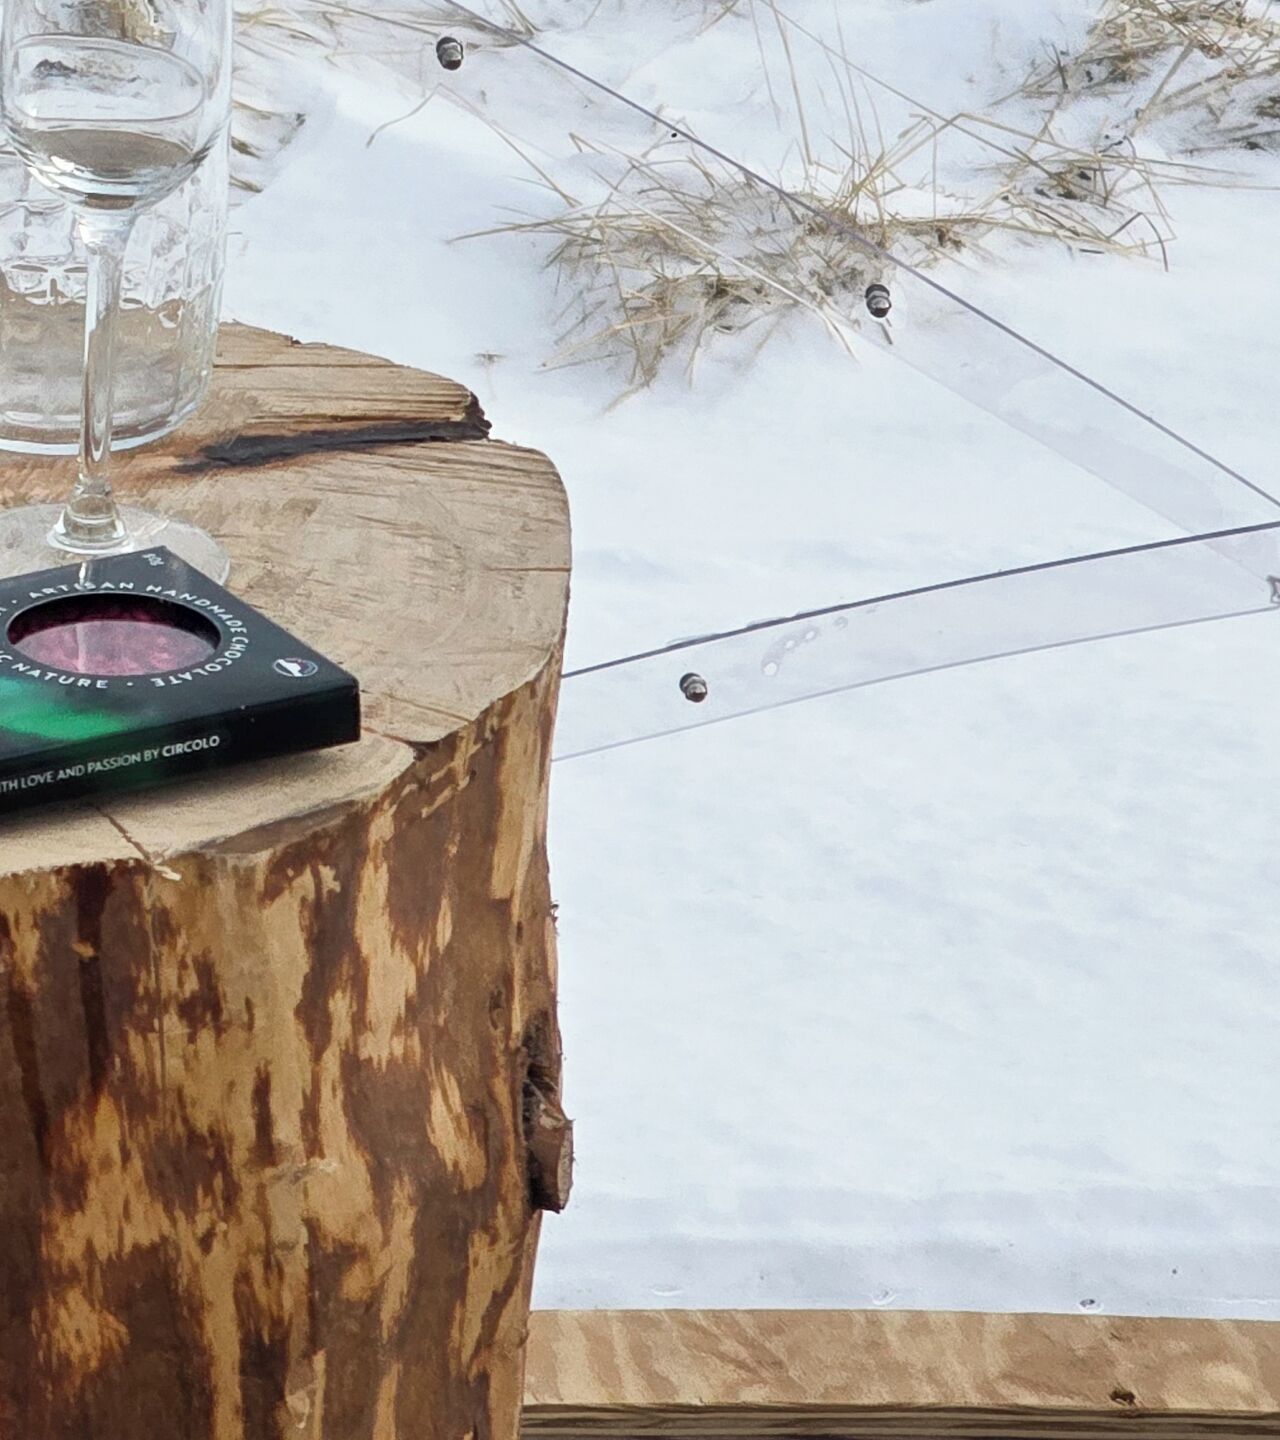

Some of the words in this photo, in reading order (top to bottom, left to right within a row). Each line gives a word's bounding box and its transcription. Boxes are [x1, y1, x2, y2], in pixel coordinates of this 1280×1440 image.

[29, 581, 134, 599] ARTISAN
[146, 584, 247, 634] HANDMADE
[11, 662, 108, 689] NATURE
[150, 636, 249, 687] CHOCOLATE
[21, 771, 54, 789] LOVE
[56, 765, 85, 780] AND
[88, 753, 141, 774] PASSION
[144, 748, 160, 762] BY
[162, 735, 220, 757] CIRCOLO
